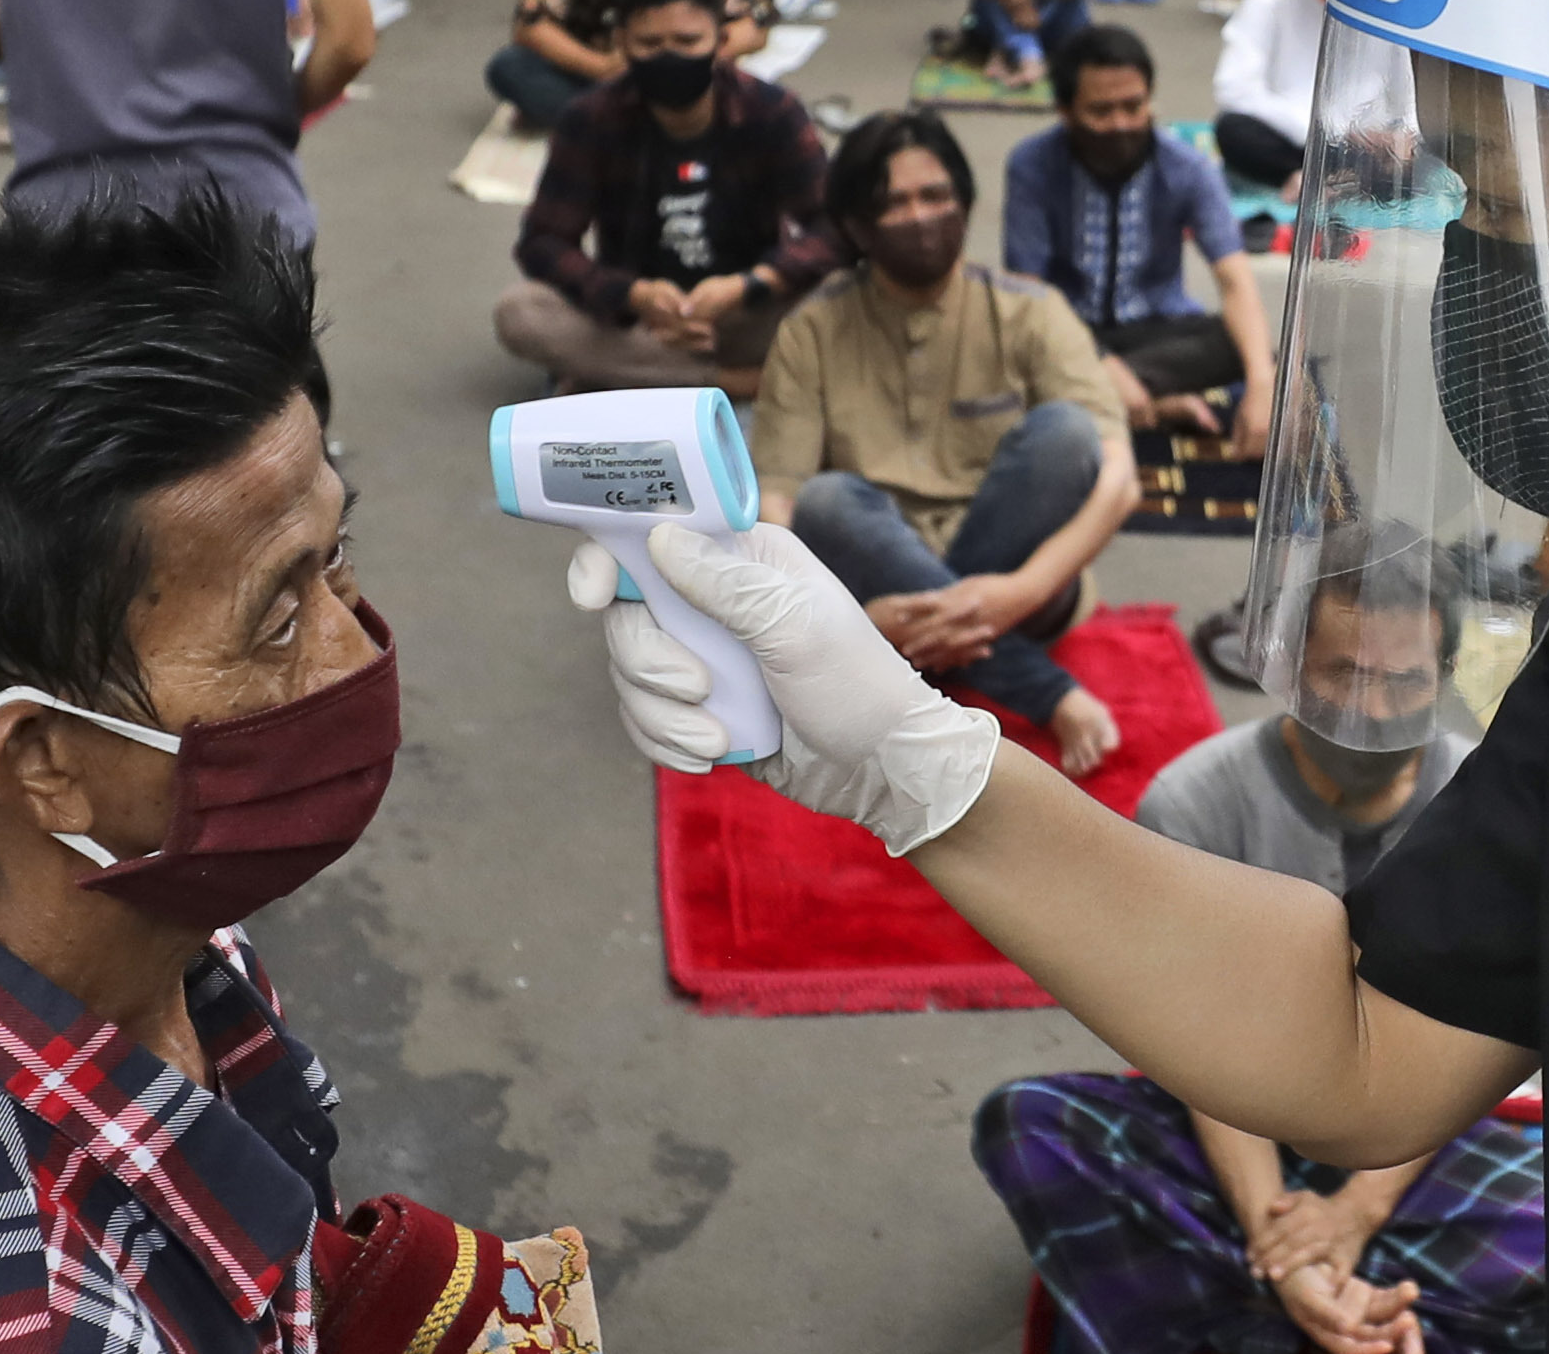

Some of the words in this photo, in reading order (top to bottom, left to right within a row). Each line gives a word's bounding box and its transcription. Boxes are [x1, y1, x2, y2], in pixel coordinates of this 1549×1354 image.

[552, 446, 618, 456] Non-Contact
[552, 458, 591, 468] Infrared
[595, 458, 663, 468] Thermometer
